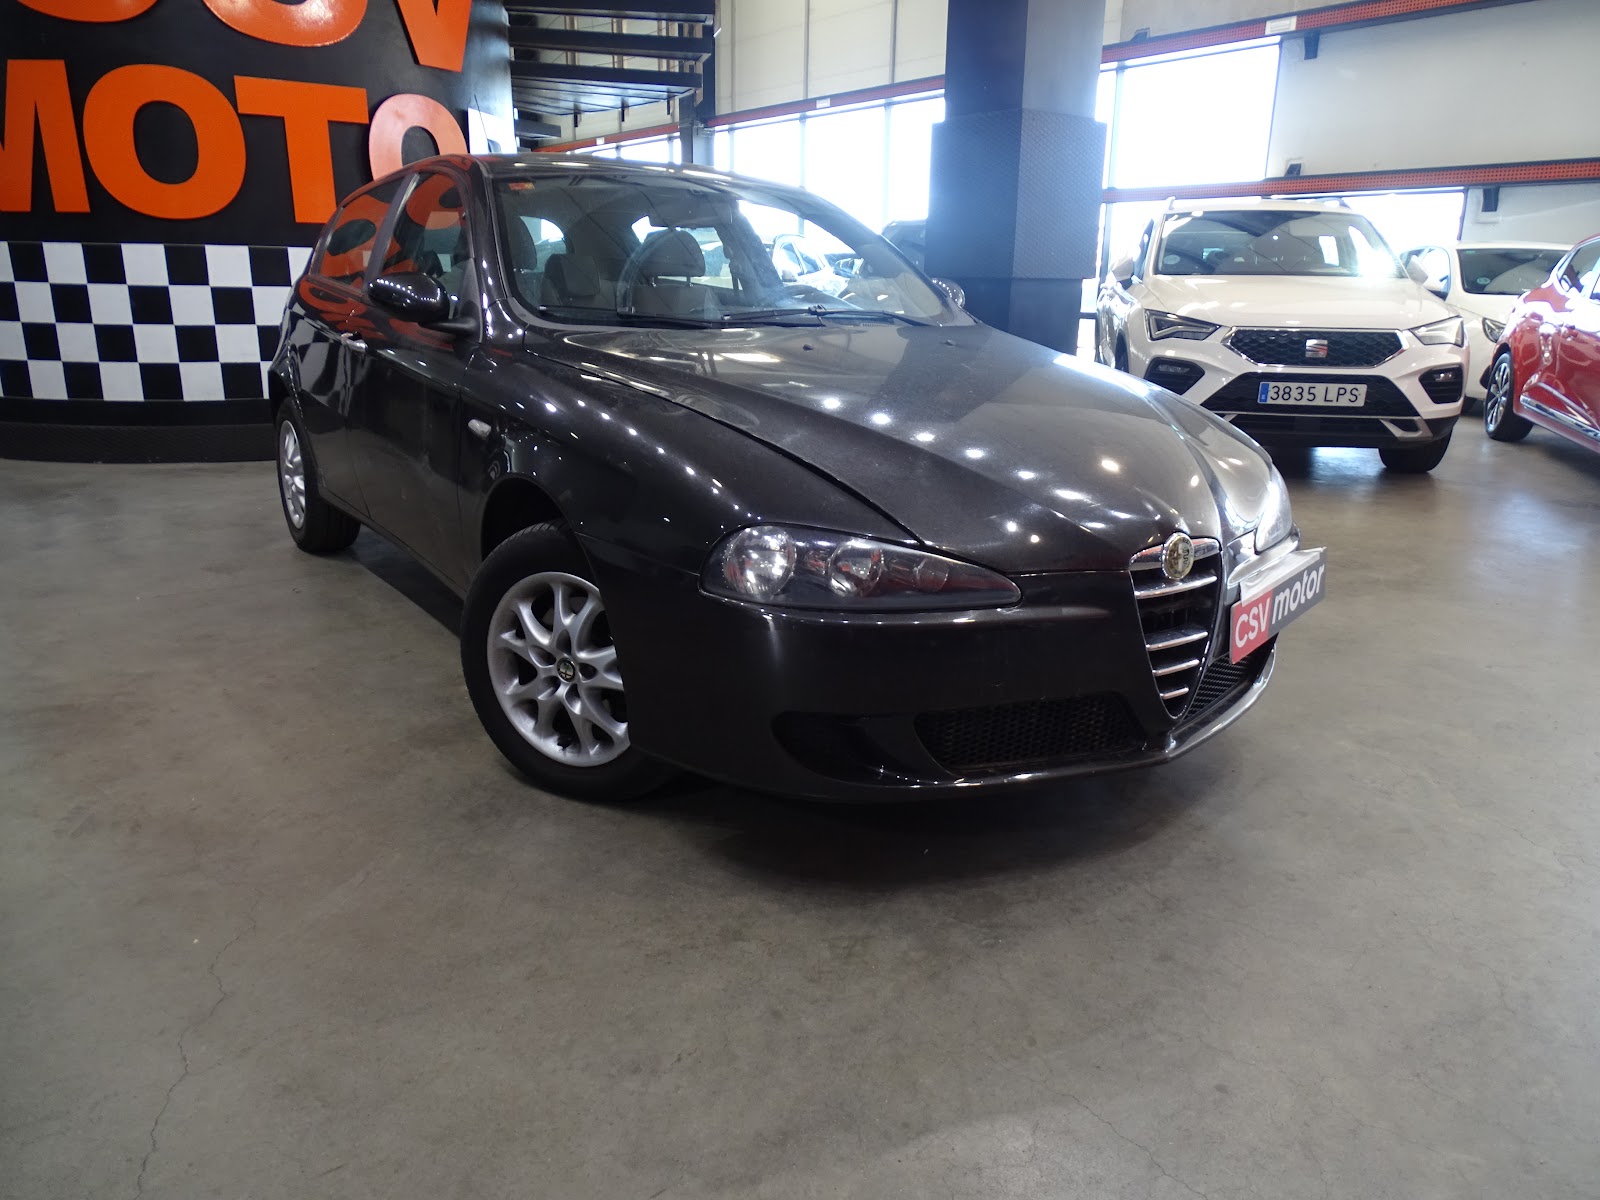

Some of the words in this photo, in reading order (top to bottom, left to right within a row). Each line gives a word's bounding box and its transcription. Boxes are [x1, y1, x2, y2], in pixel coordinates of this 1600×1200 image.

[1270, 385, 1317, 402] 3835
[1323, 386, 1361, 403] LPS
[1235, 597, 1271, 648] CSV
[1271, 563, 1325, 625] motor
